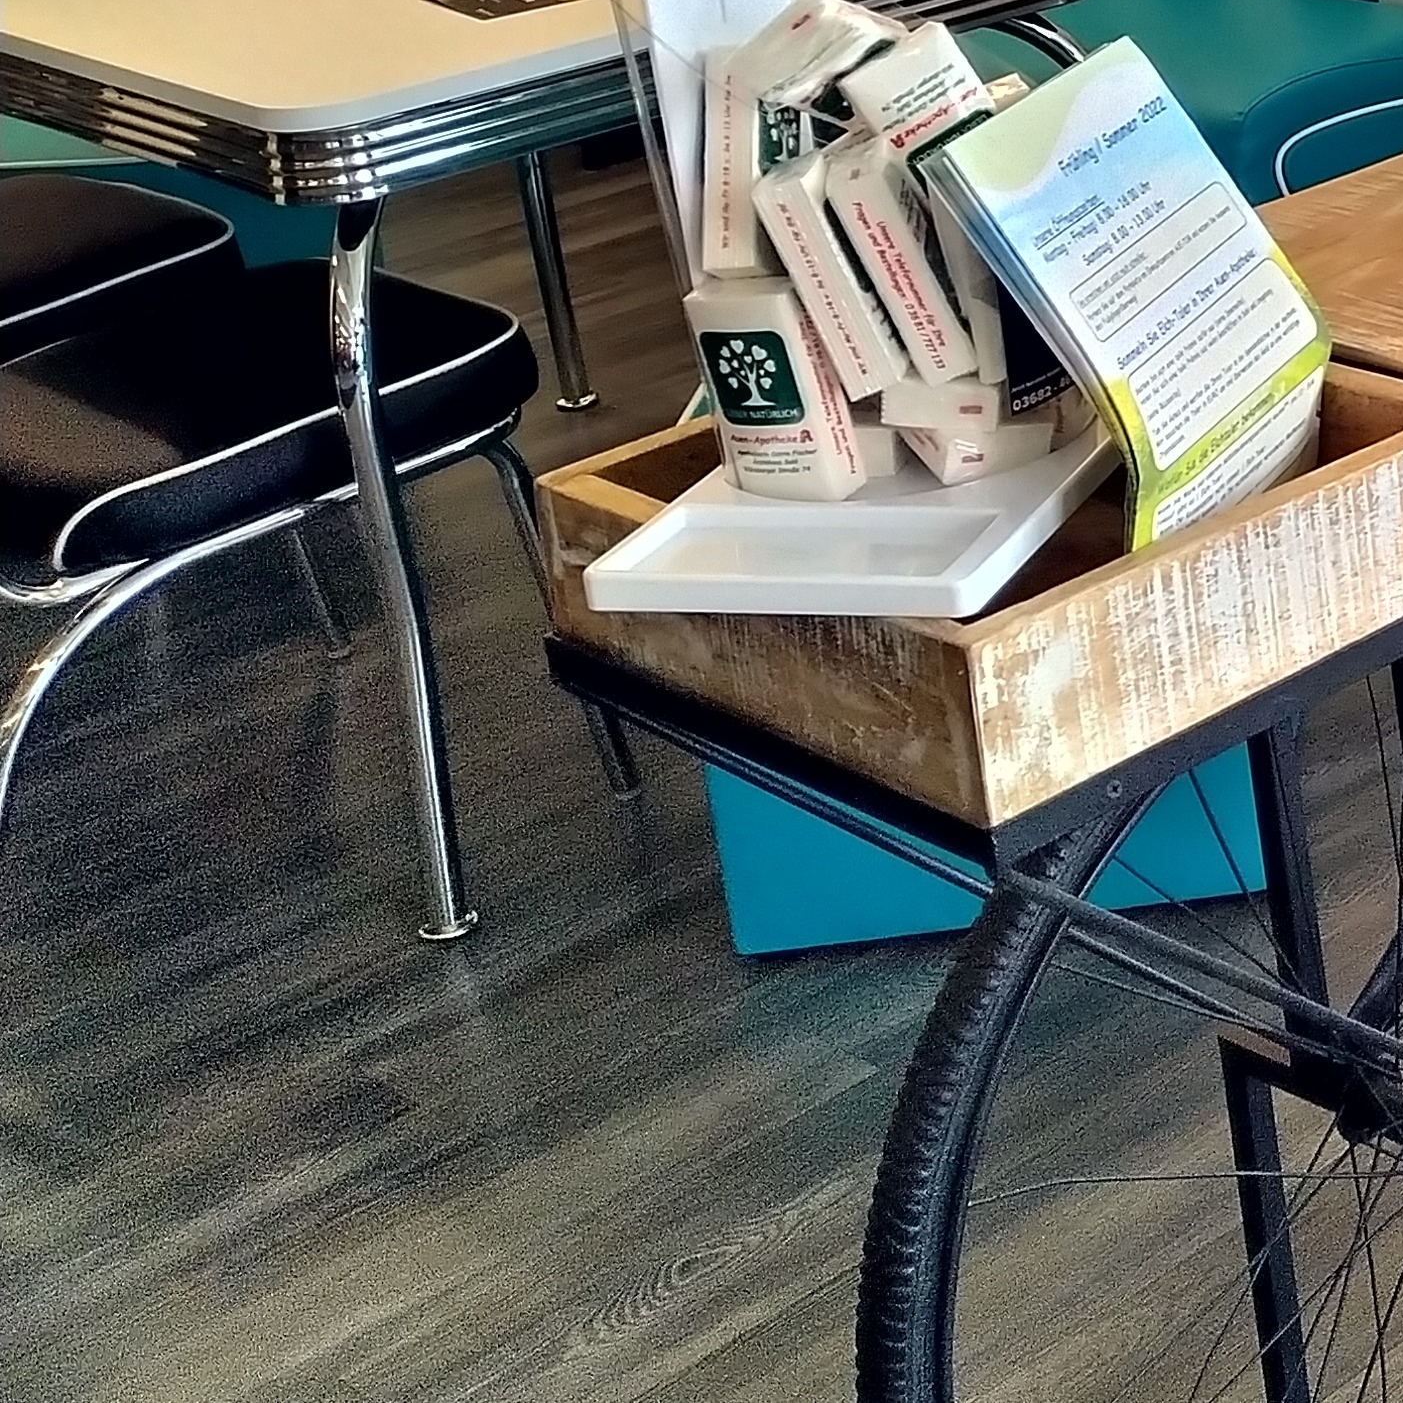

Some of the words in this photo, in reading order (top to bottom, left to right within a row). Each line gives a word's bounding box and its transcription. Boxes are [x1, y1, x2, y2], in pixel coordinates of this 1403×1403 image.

[1102, 119, 1138, 148] Sommer
[1138, 96, 1167, 123] 2022
[852, 202, 871, 230] Fragen
[868, 233, 882, 247] und
[877, 221, 895, 249] Unsere
[747, 408, 800, 419] NATÜRLICH
[730, 433, 797, 446] Auen-Apotheke
